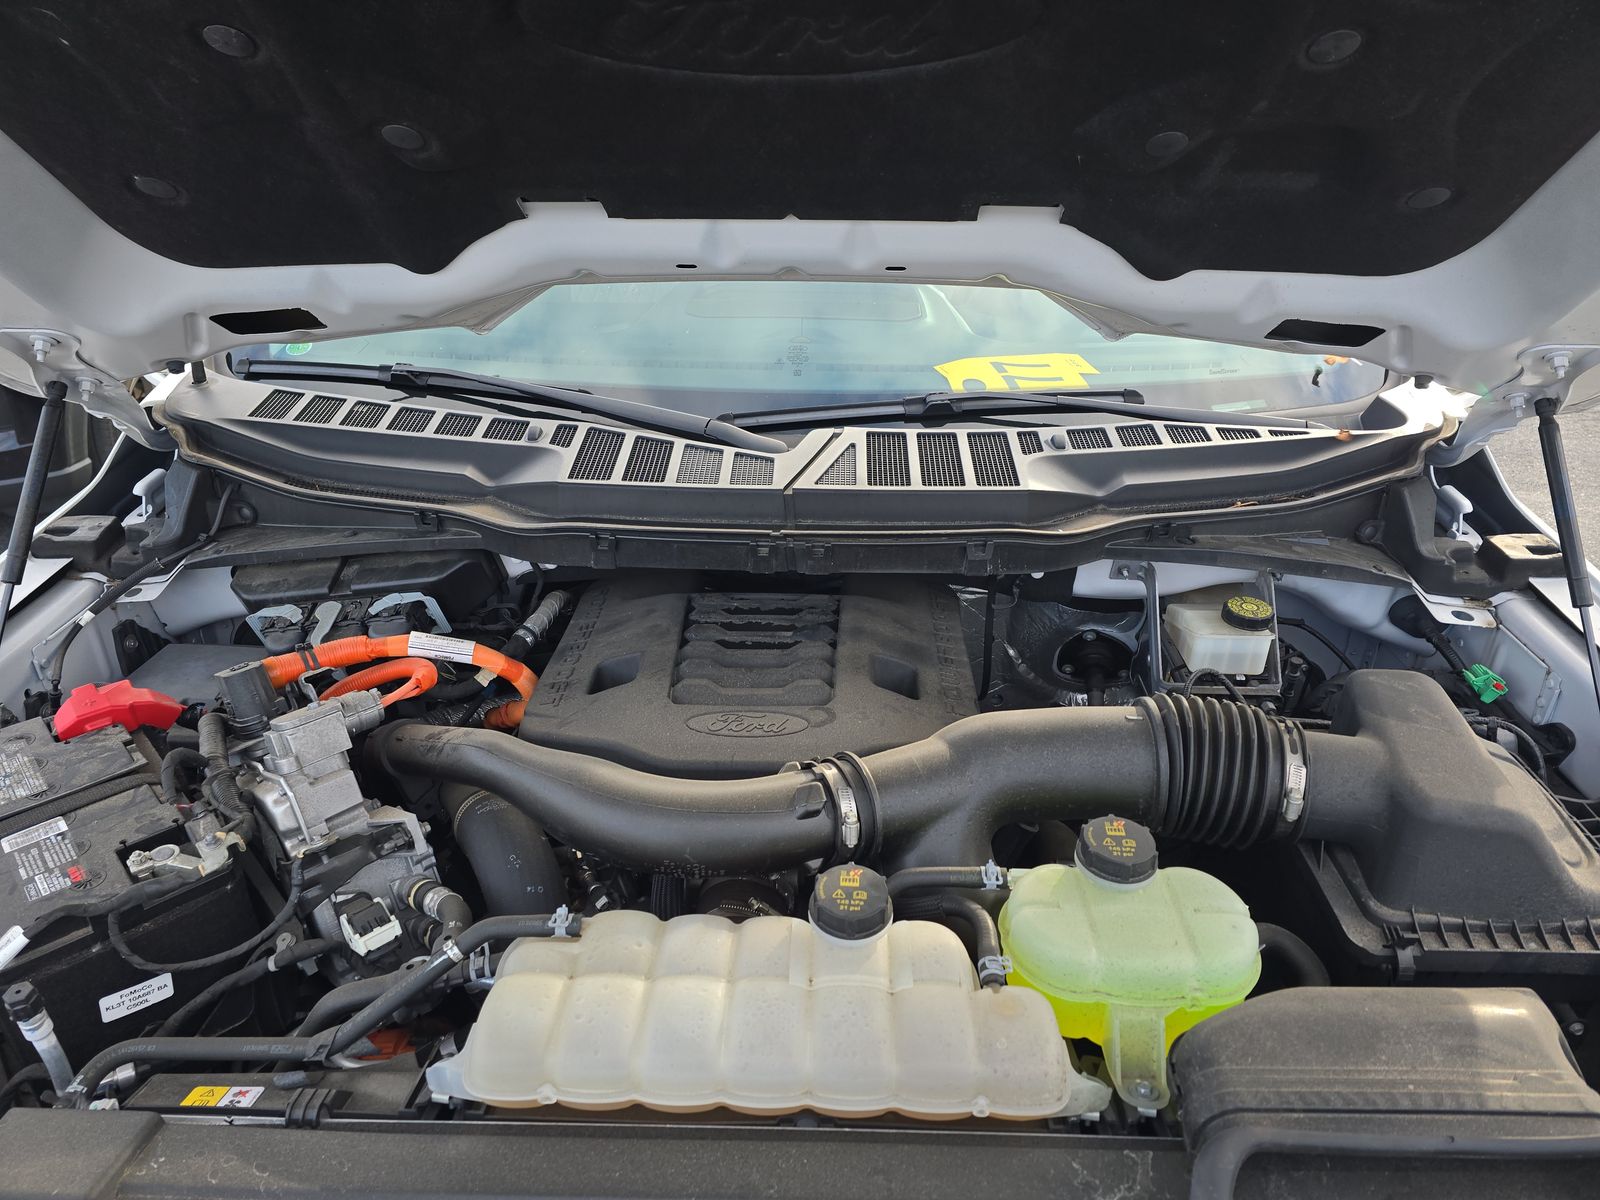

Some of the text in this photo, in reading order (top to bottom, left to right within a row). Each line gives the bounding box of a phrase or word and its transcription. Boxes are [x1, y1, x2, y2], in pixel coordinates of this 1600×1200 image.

[707, 713, 790, 733] Ford
[119, 984, 153, 1000] FoMoCo
[157, 983, 168, 991] BA
